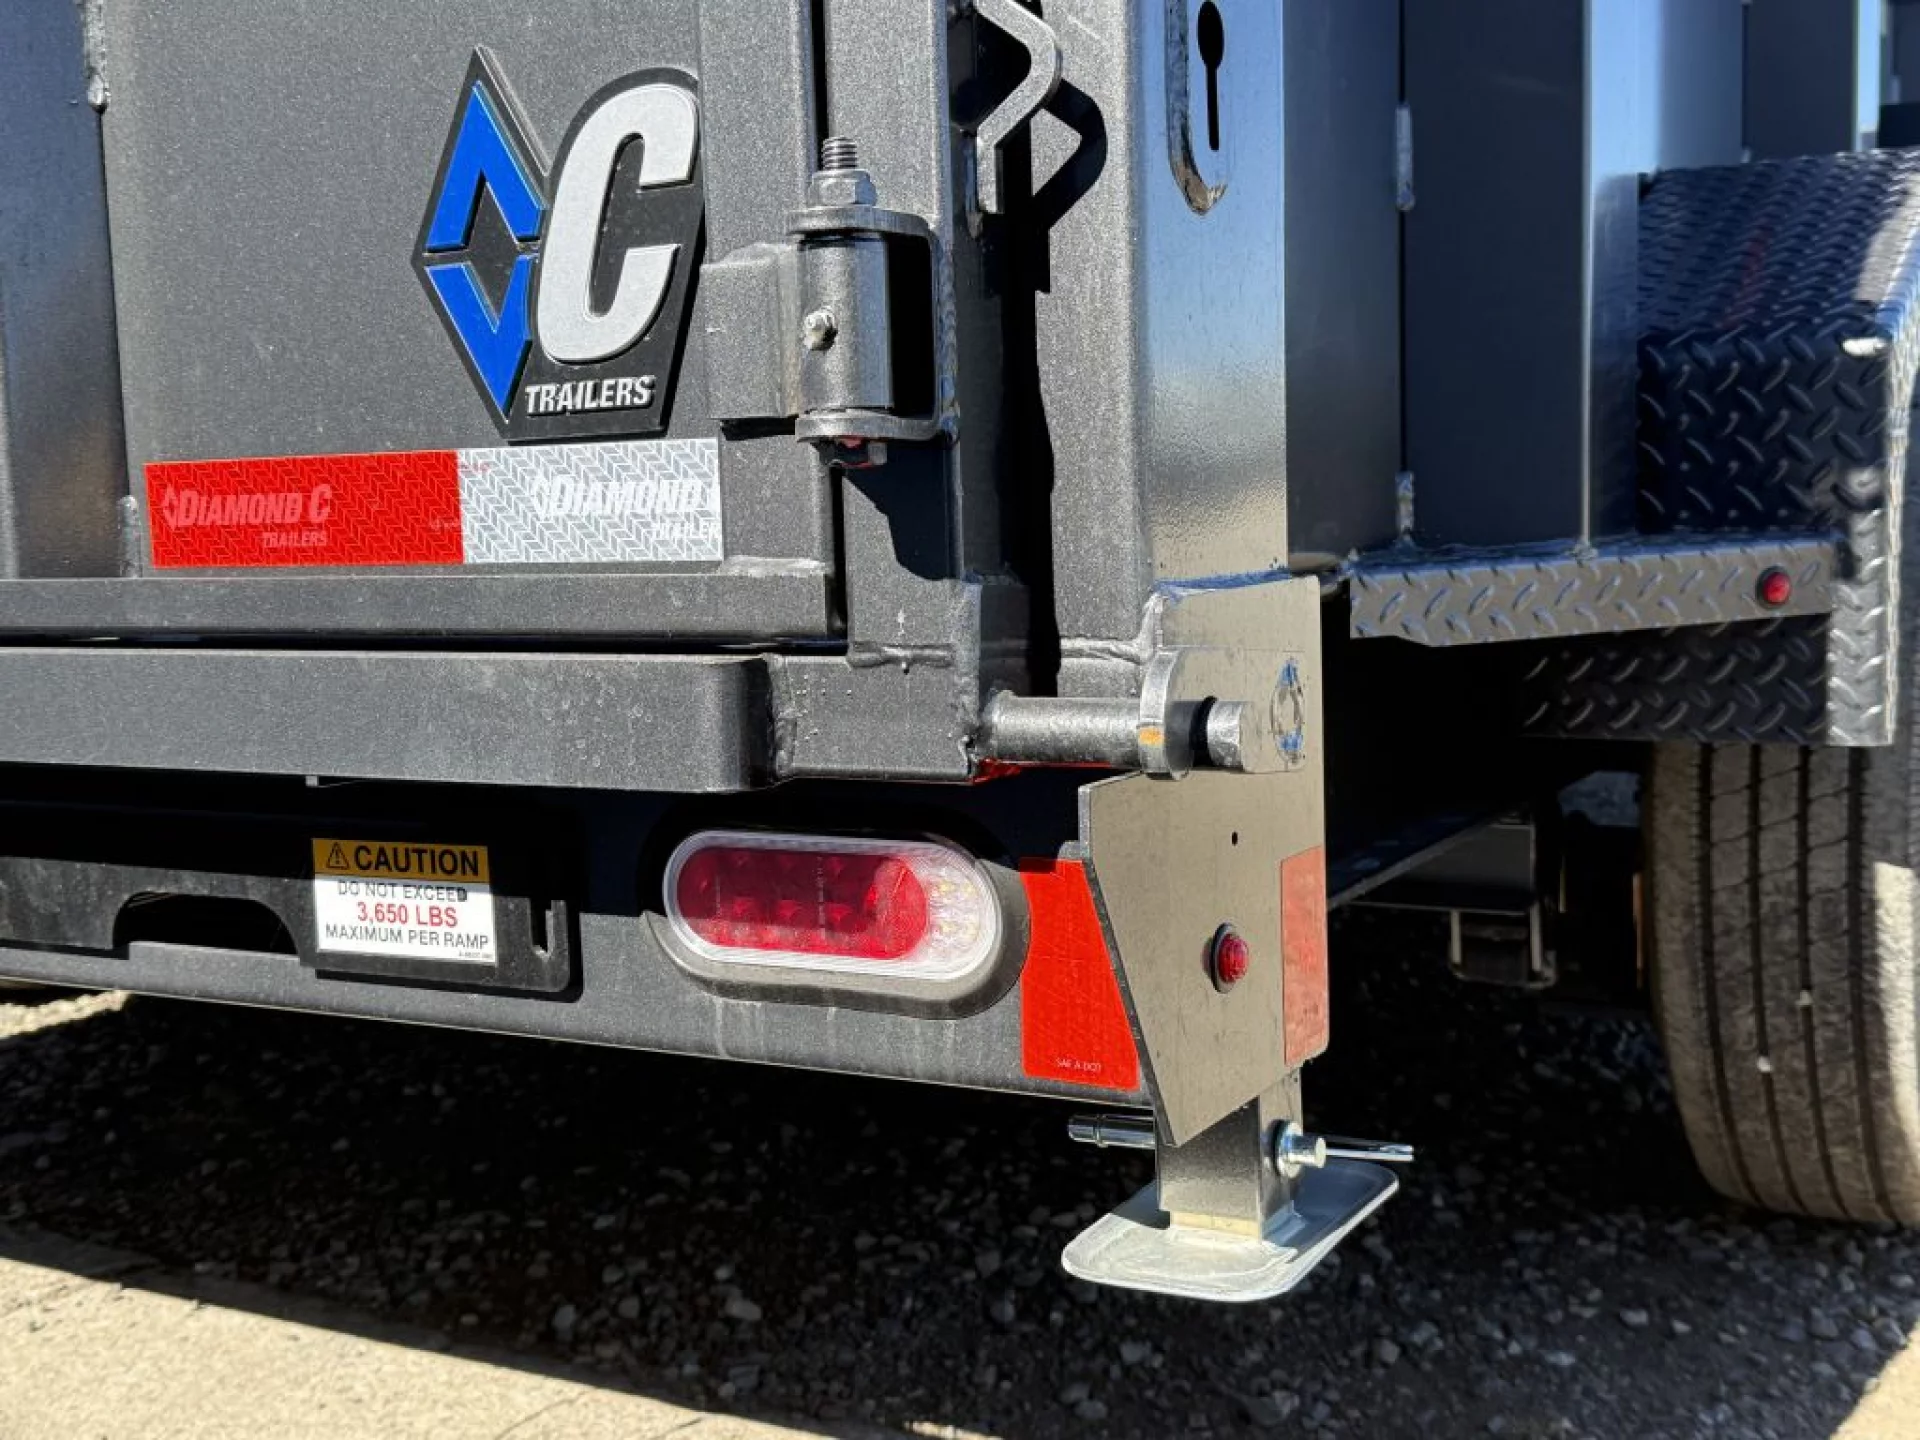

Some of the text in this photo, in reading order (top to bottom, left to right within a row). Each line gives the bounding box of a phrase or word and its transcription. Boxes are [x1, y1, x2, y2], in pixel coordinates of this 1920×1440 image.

[537, 83, 699, 361] C
[525, 375, 655, 413] TRAILERS
[178, 483, 333, 527] DIAMOND C
[262, 531, 327, 548] TRAILERS
[354, 845, 479, 877] CAUTION
[338, 880, 468, 903] DO NOT EXCEED
[357, 901, 458, 929] 3,650 LBS
[325, 922, 489, 950] MAXIMUM PER RAMP
